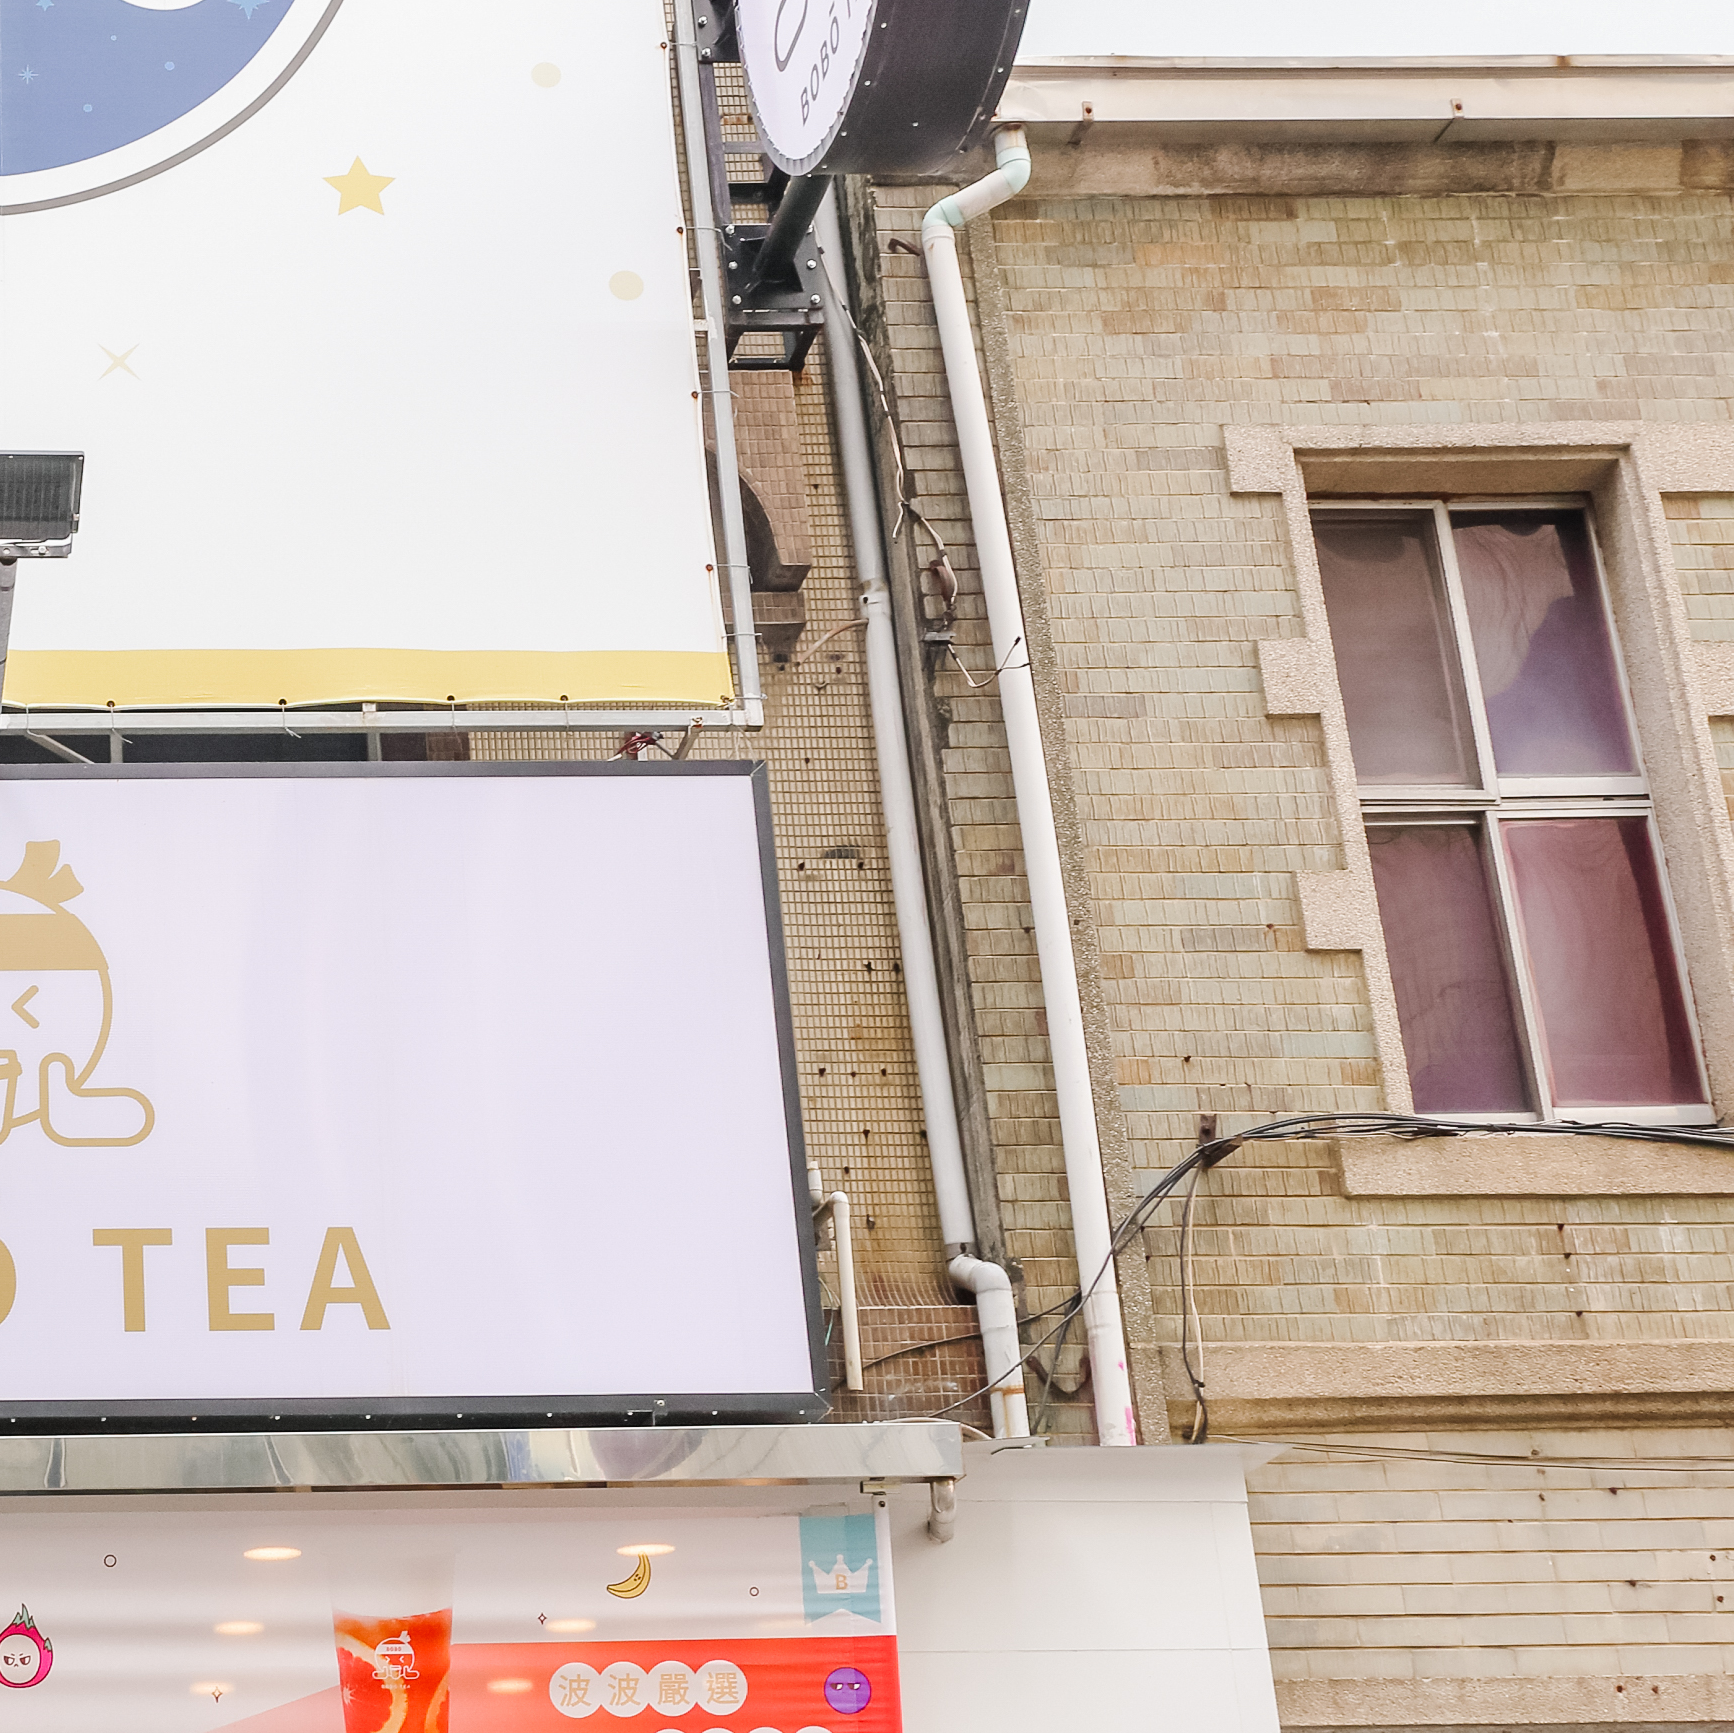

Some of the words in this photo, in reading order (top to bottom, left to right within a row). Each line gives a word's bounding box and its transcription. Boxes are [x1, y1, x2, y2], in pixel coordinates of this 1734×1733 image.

[92, 1226, 392, 1333] TEA
[557, 1670, 742, 1708] 波波嚴選
